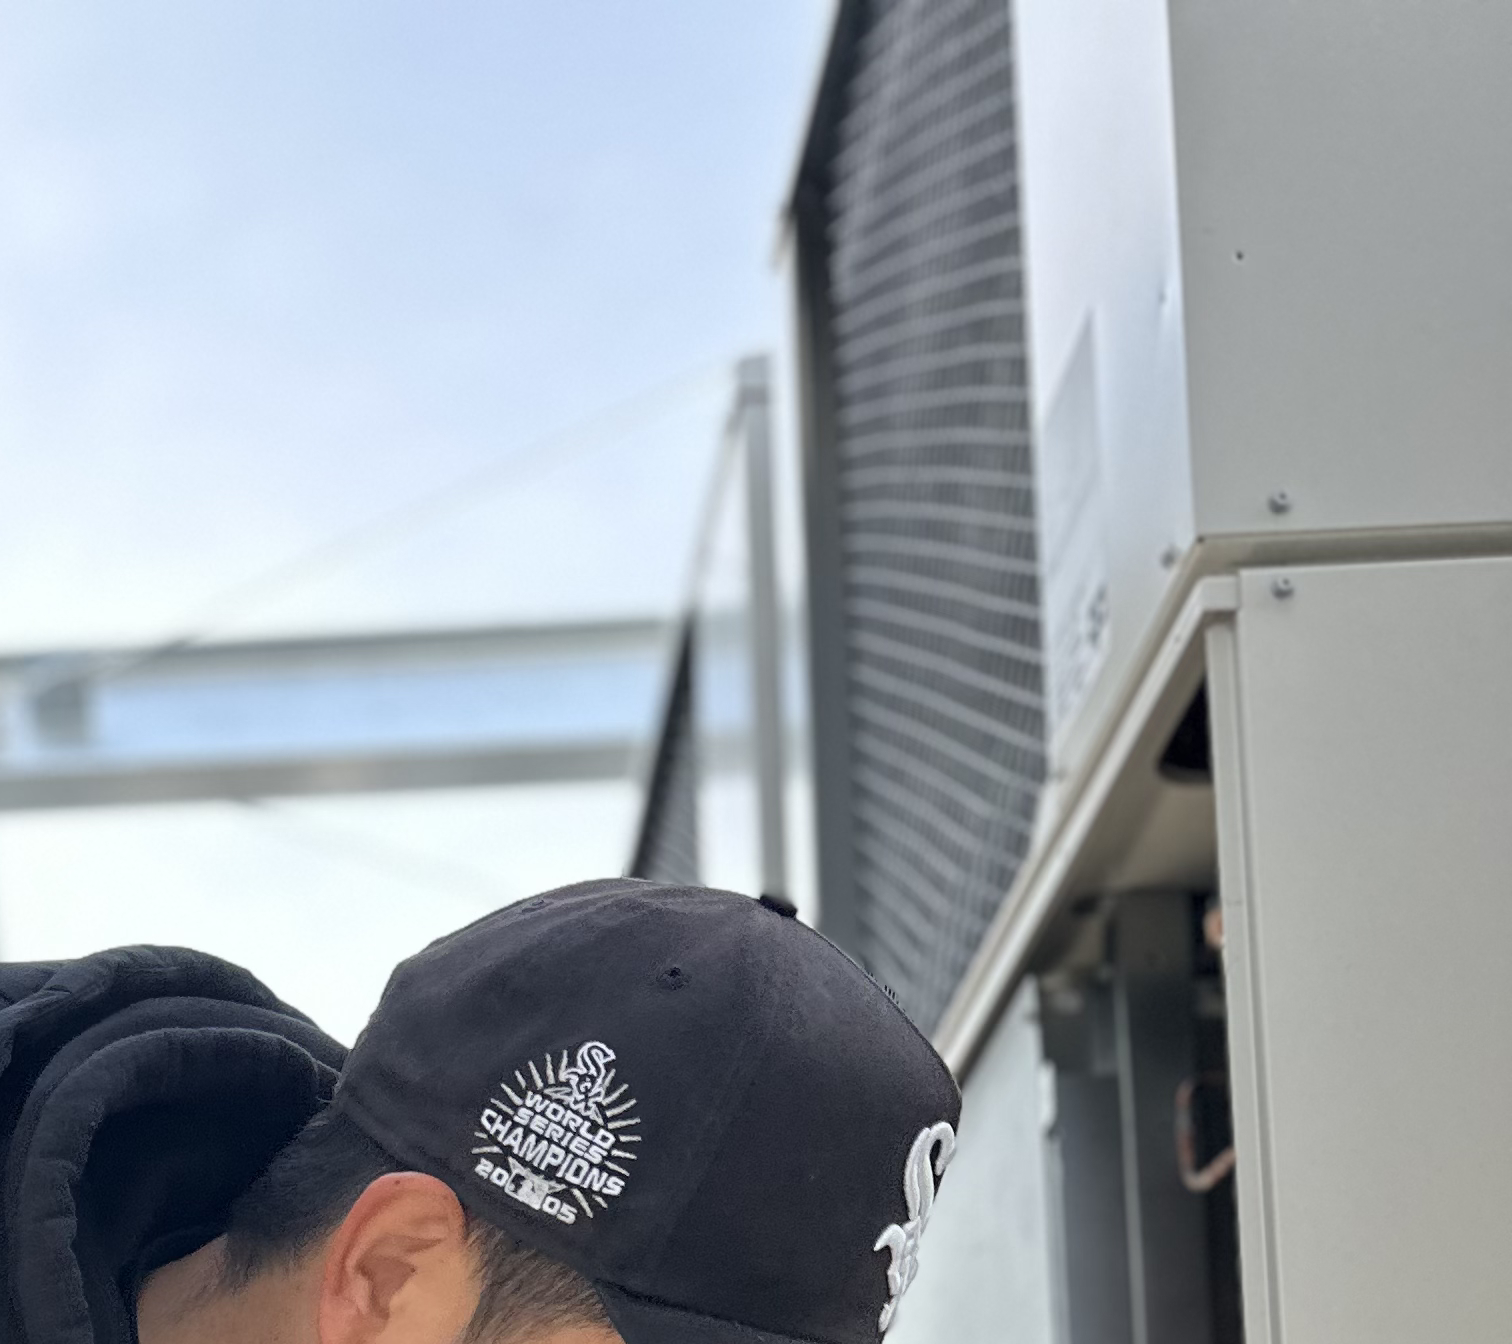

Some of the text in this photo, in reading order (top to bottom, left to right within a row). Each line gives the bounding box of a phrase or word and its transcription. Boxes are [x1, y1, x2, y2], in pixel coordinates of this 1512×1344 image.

[513, 1107, 608, 1165] SERIES
[525, 1090, 615, 1150] WORLD
[480, 1108, 626, 1196] CHAMPIONS
